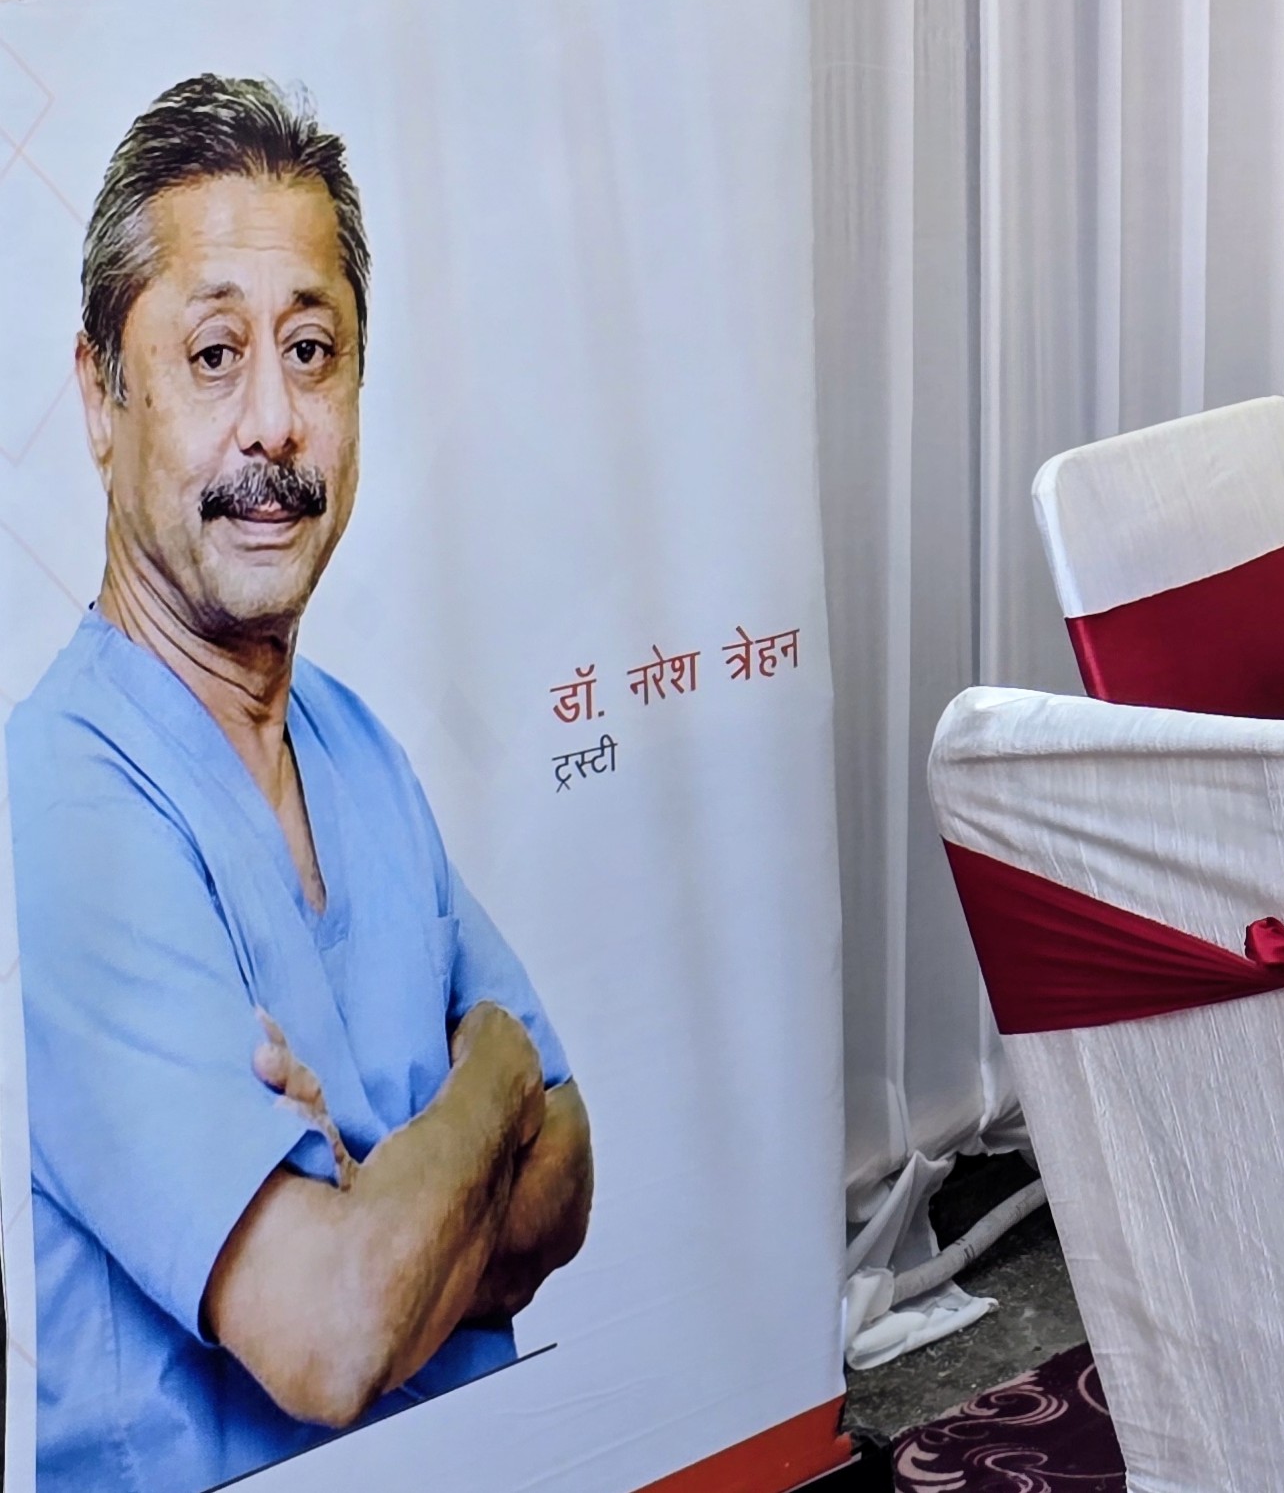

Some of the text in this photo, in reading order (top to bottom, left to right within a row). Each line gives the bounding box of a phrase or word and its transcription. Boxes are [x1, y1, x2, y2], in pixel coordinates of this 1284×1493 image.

[550, 626, 800, 723] डॉ. नरेश त्रेहन
[552, 734, 617, 792] ट्रस्टी
